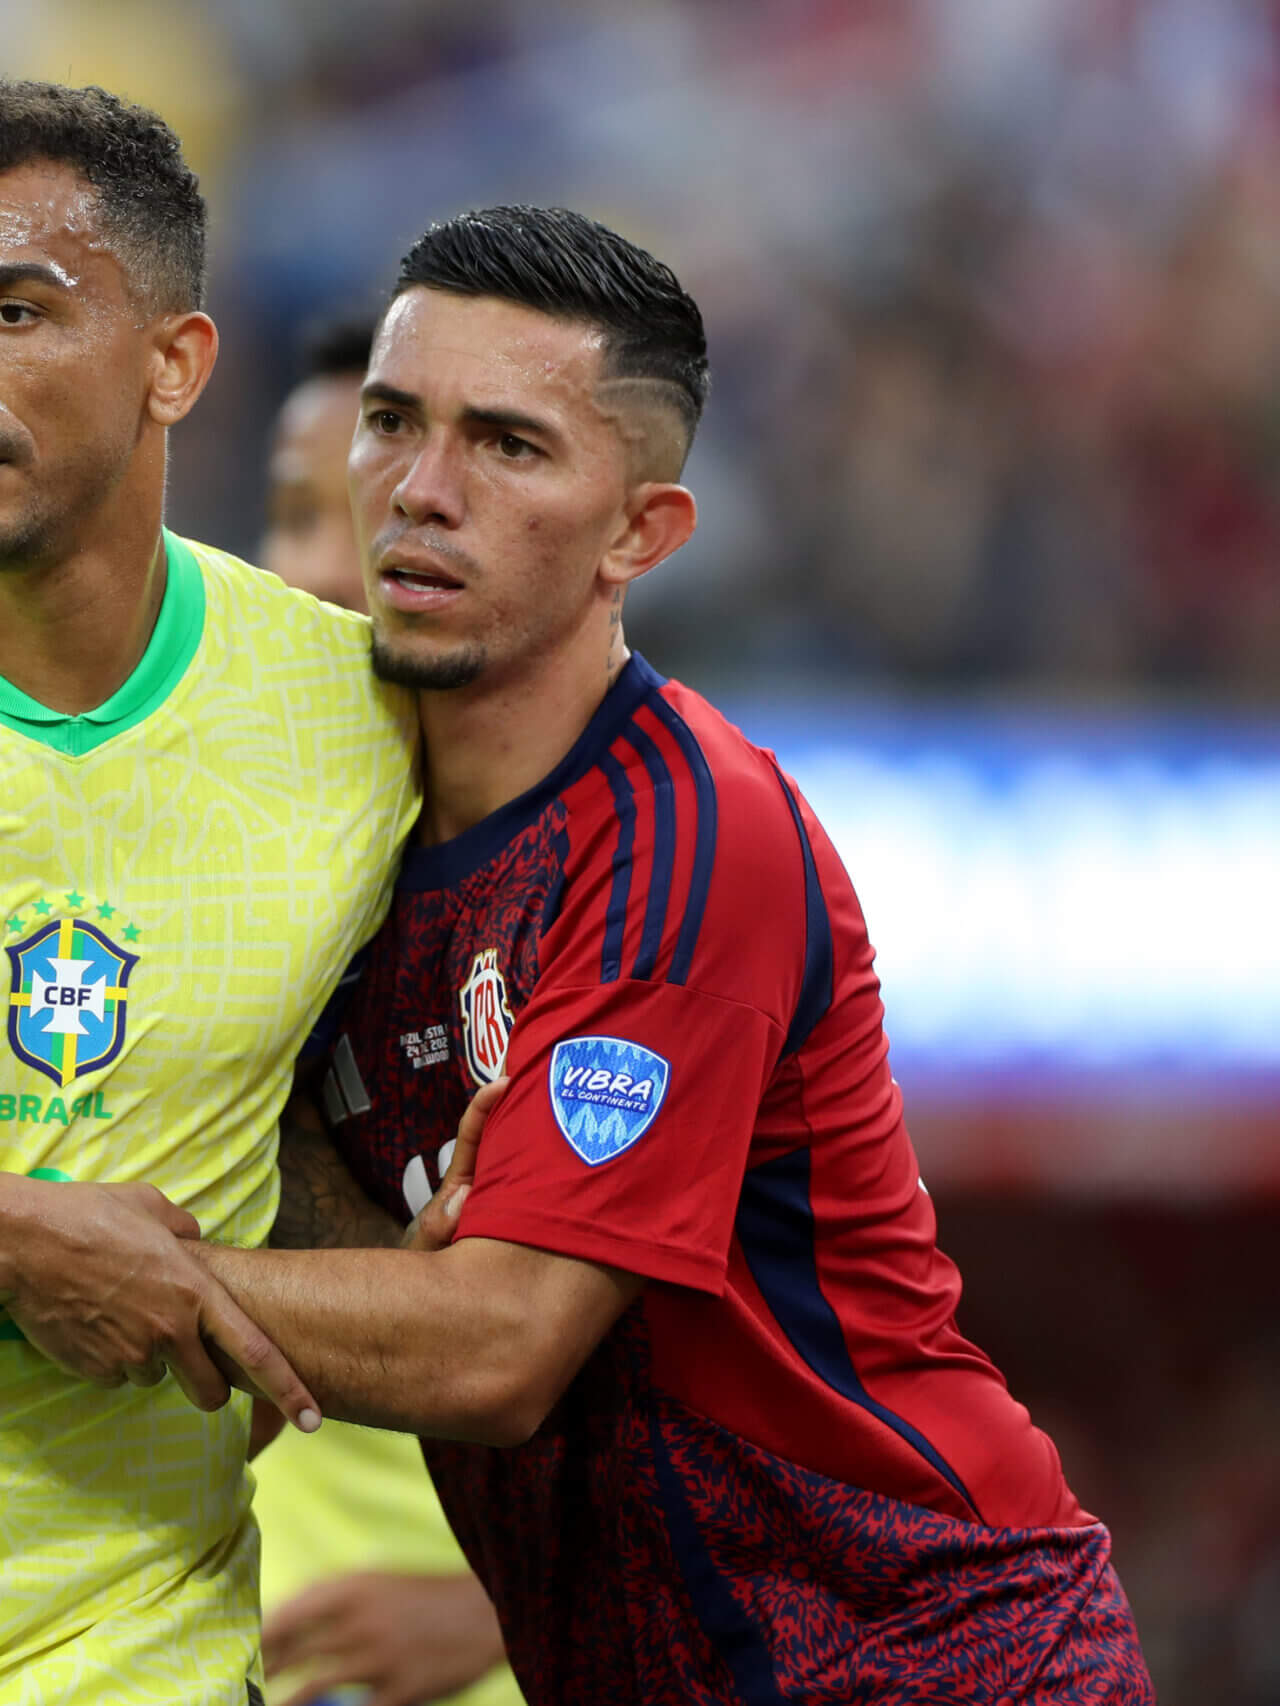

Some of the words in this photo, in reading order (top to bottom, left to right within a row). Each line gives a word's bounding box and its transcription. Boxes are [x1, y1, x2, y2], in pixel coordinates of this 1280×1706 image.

[44, 986, 92, 1007] CBF
[563, 1066, 652, 1101] VIBRA
[561, 1088, 574, 1097] EL
[577, 1091, 648, 1111] CONTINENTE
